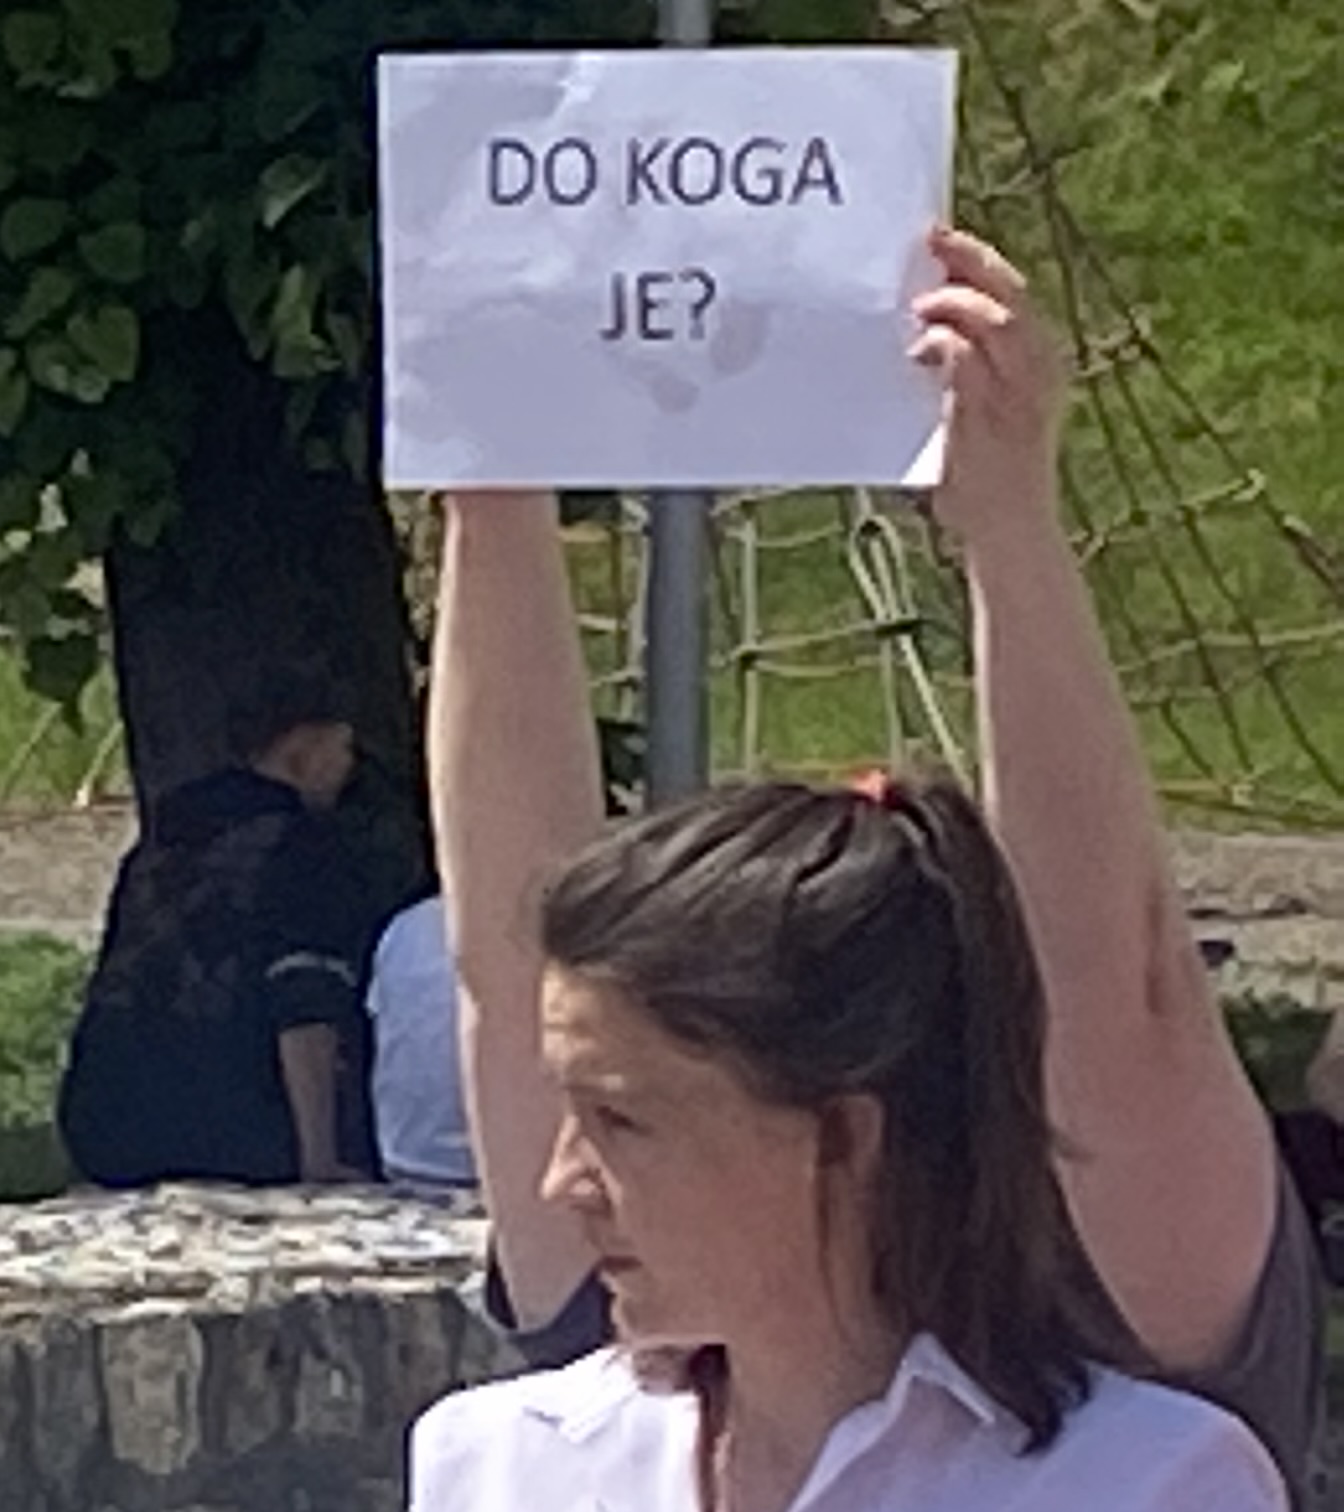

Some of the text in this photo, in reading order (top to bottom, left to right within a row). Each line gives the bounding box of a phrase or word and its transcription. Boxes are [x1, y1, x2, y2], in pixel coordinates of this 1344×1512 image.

[486, 136, 845, 208] DO KOGA
[597, 269, 718, 343] JE?
